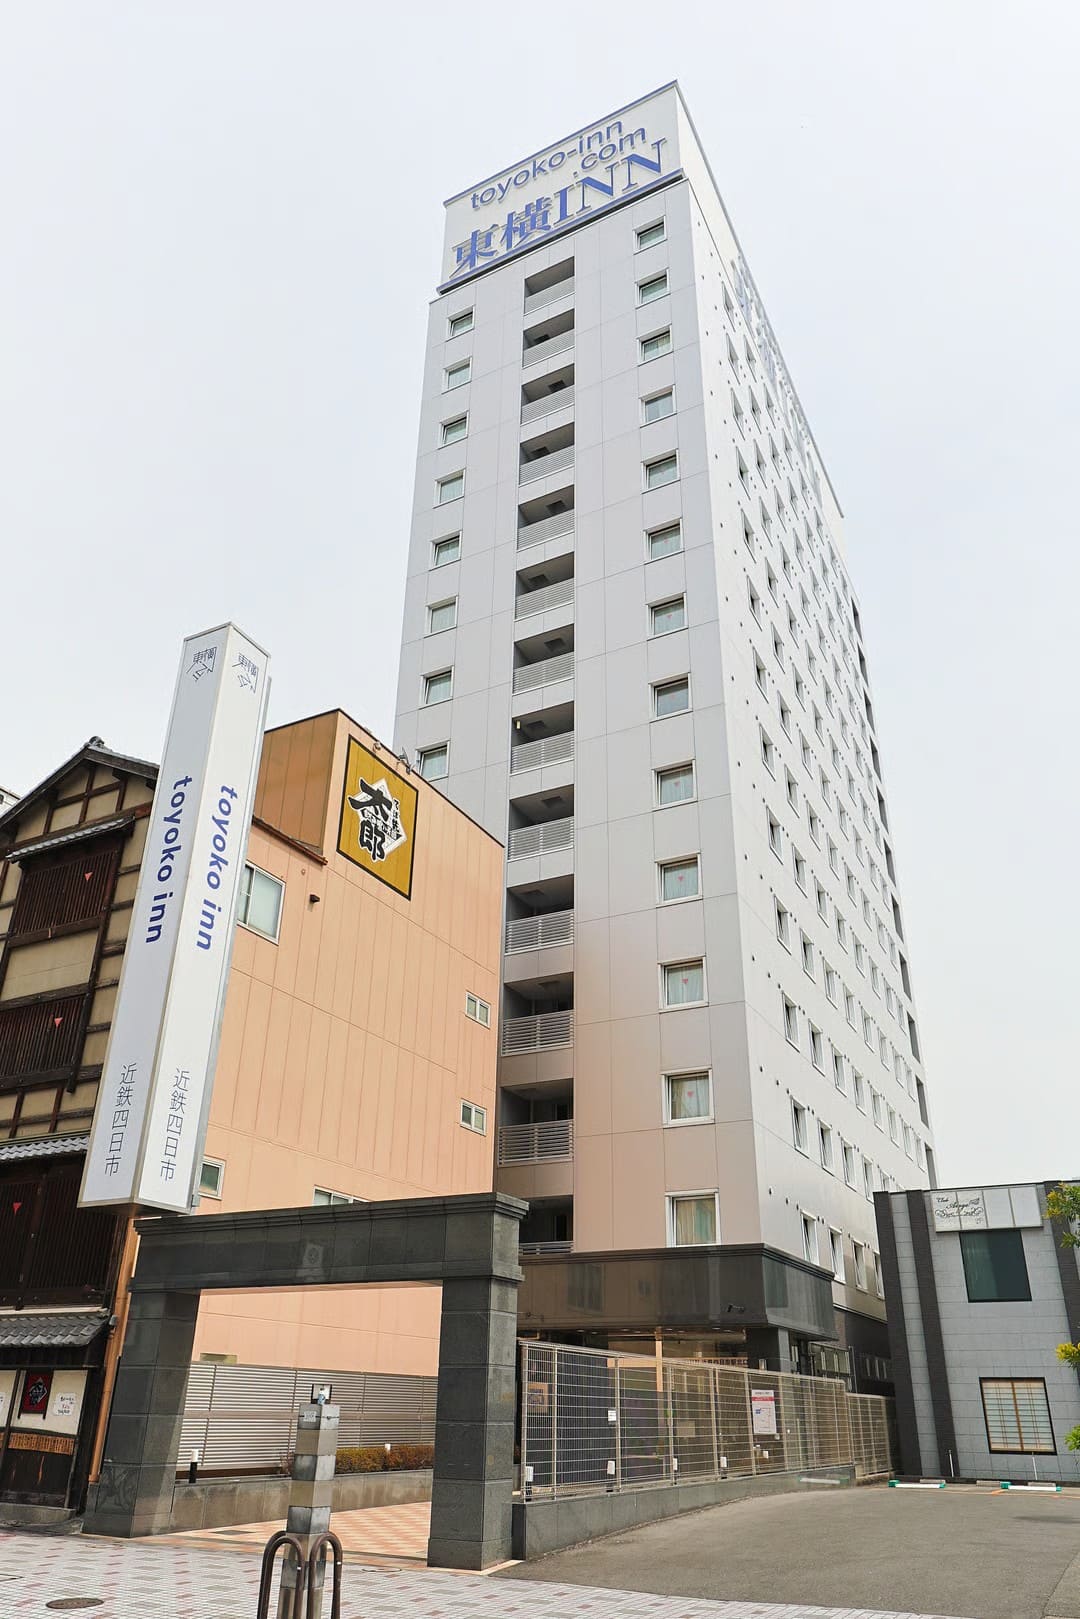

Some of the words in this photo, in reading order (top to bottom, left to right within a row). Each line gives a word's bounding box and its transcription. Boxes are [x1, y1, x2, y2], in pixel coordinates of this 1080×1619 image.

[471, 120, 623, 210] toyoko-inn
[573, 127, 647, 179] .com
[157, 775, 193, 882] toyoko
[202, 784, 238, 890] toyoko
[146, 891, 174, 944] inn
[197, 898, 222, 951] inn
[104, 1062, 137, 1177] 近鉄四日市
[160, 1067, 190, 1181] 近鉄四日市
